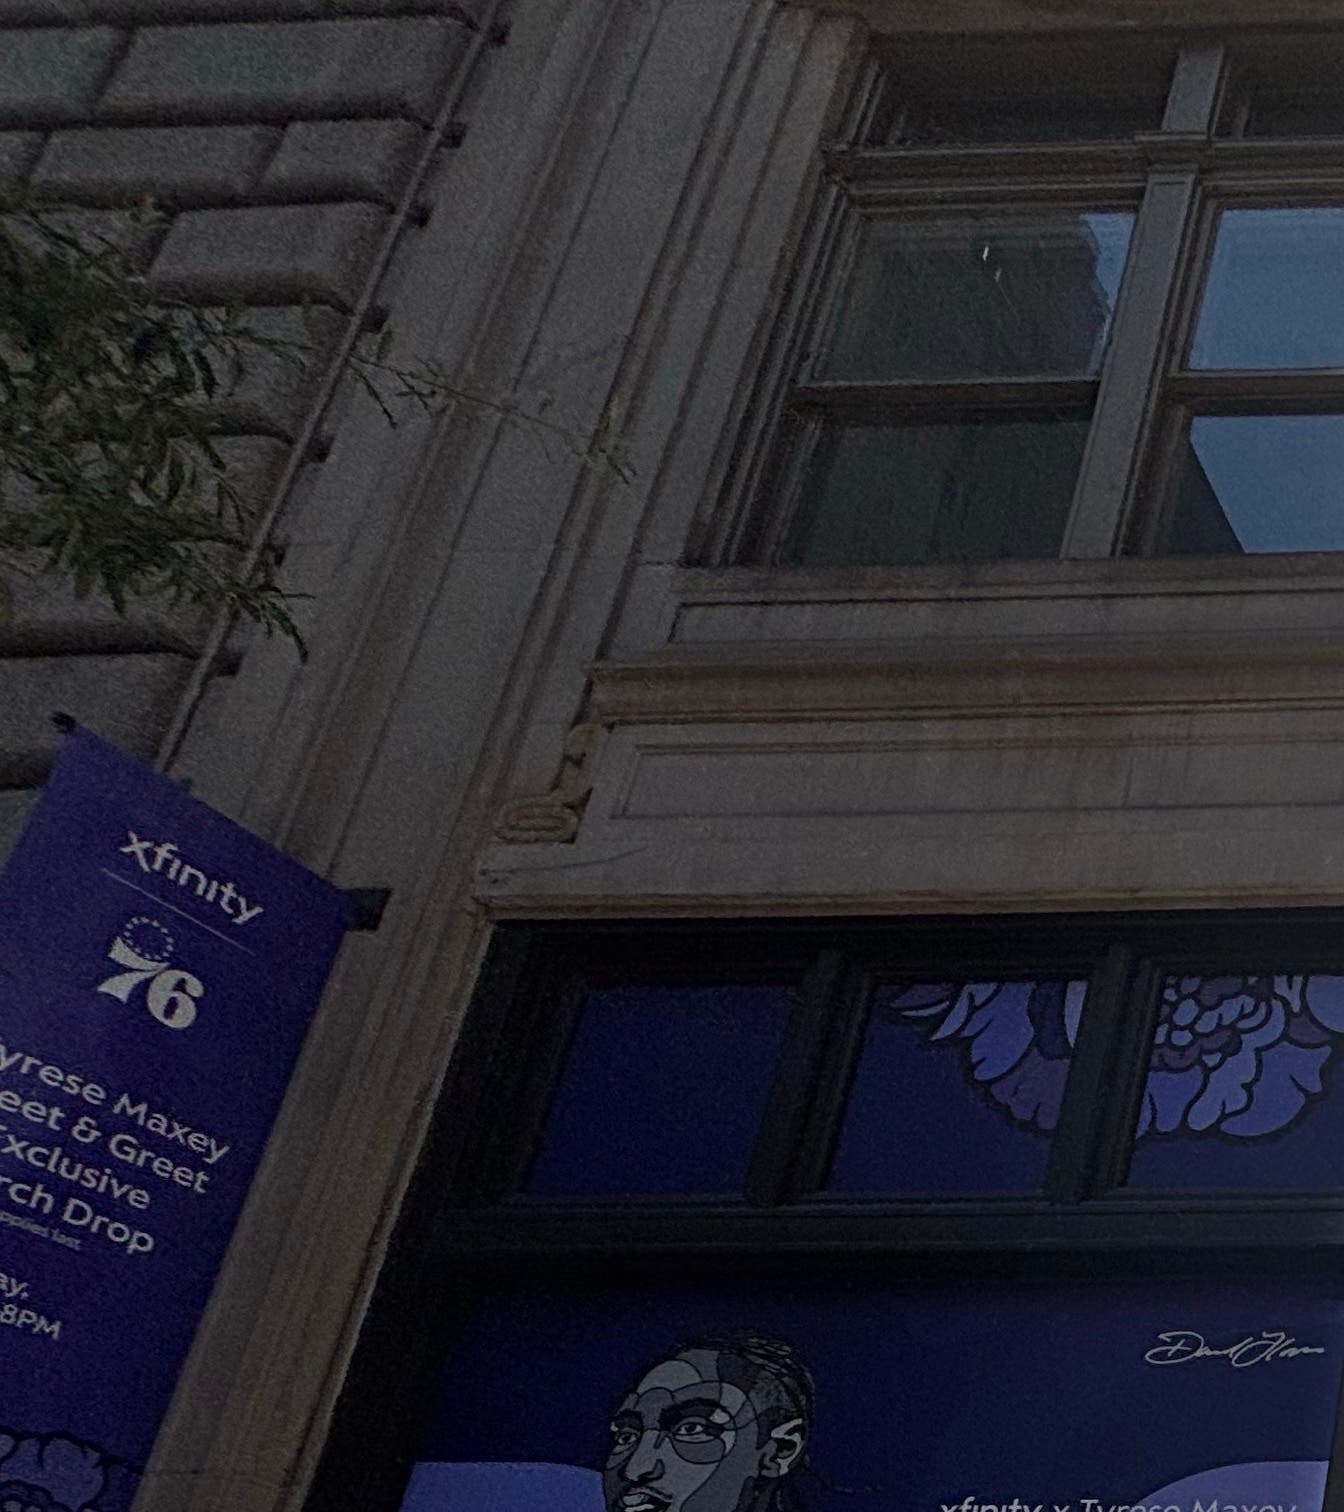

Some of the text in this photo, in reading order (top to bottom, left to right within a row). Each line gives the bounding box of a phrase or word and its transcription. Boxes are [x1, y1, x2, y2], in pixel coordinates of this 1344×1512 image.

[120, 831, 264, 924] xfinity
[97, 936, 204, 1028] 76
[0, 1043, 229, 1164] yrese Maxey
[0, 1090, 210, 1194] eet & Greet
[0, 1125, 150, 1210] xclusive
[62, 1197, 154, 1254] Drop
[0, 1303, 62, 1340] 8PM
